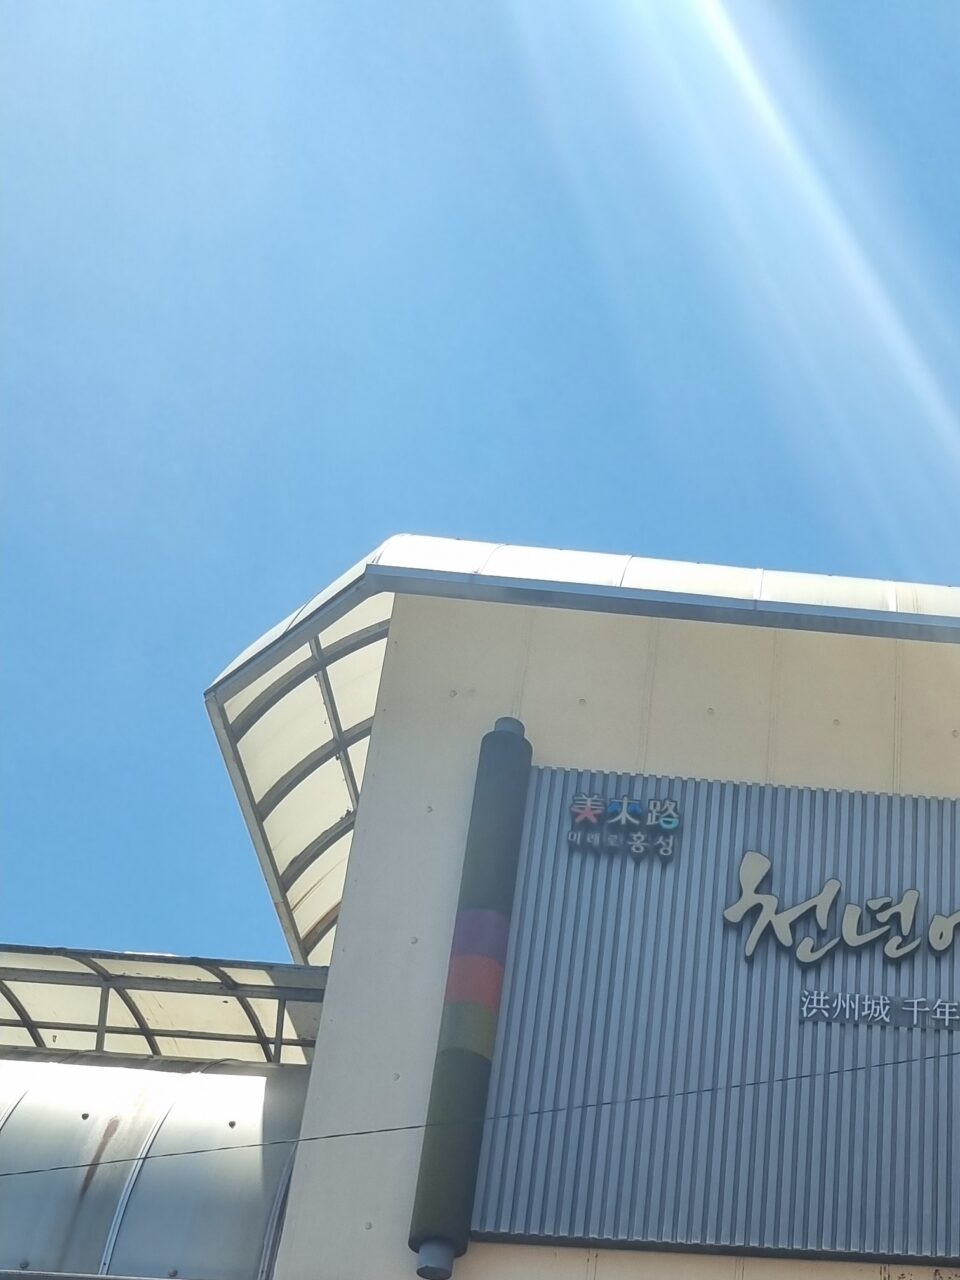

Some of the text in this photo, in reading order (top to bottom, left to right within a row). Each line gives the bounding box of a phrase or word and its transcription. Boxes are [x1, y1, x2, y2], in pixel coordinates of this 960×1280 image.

[626, 831, 673, 855] 홍성
[801, 990, 890, 1023] 洪州城
